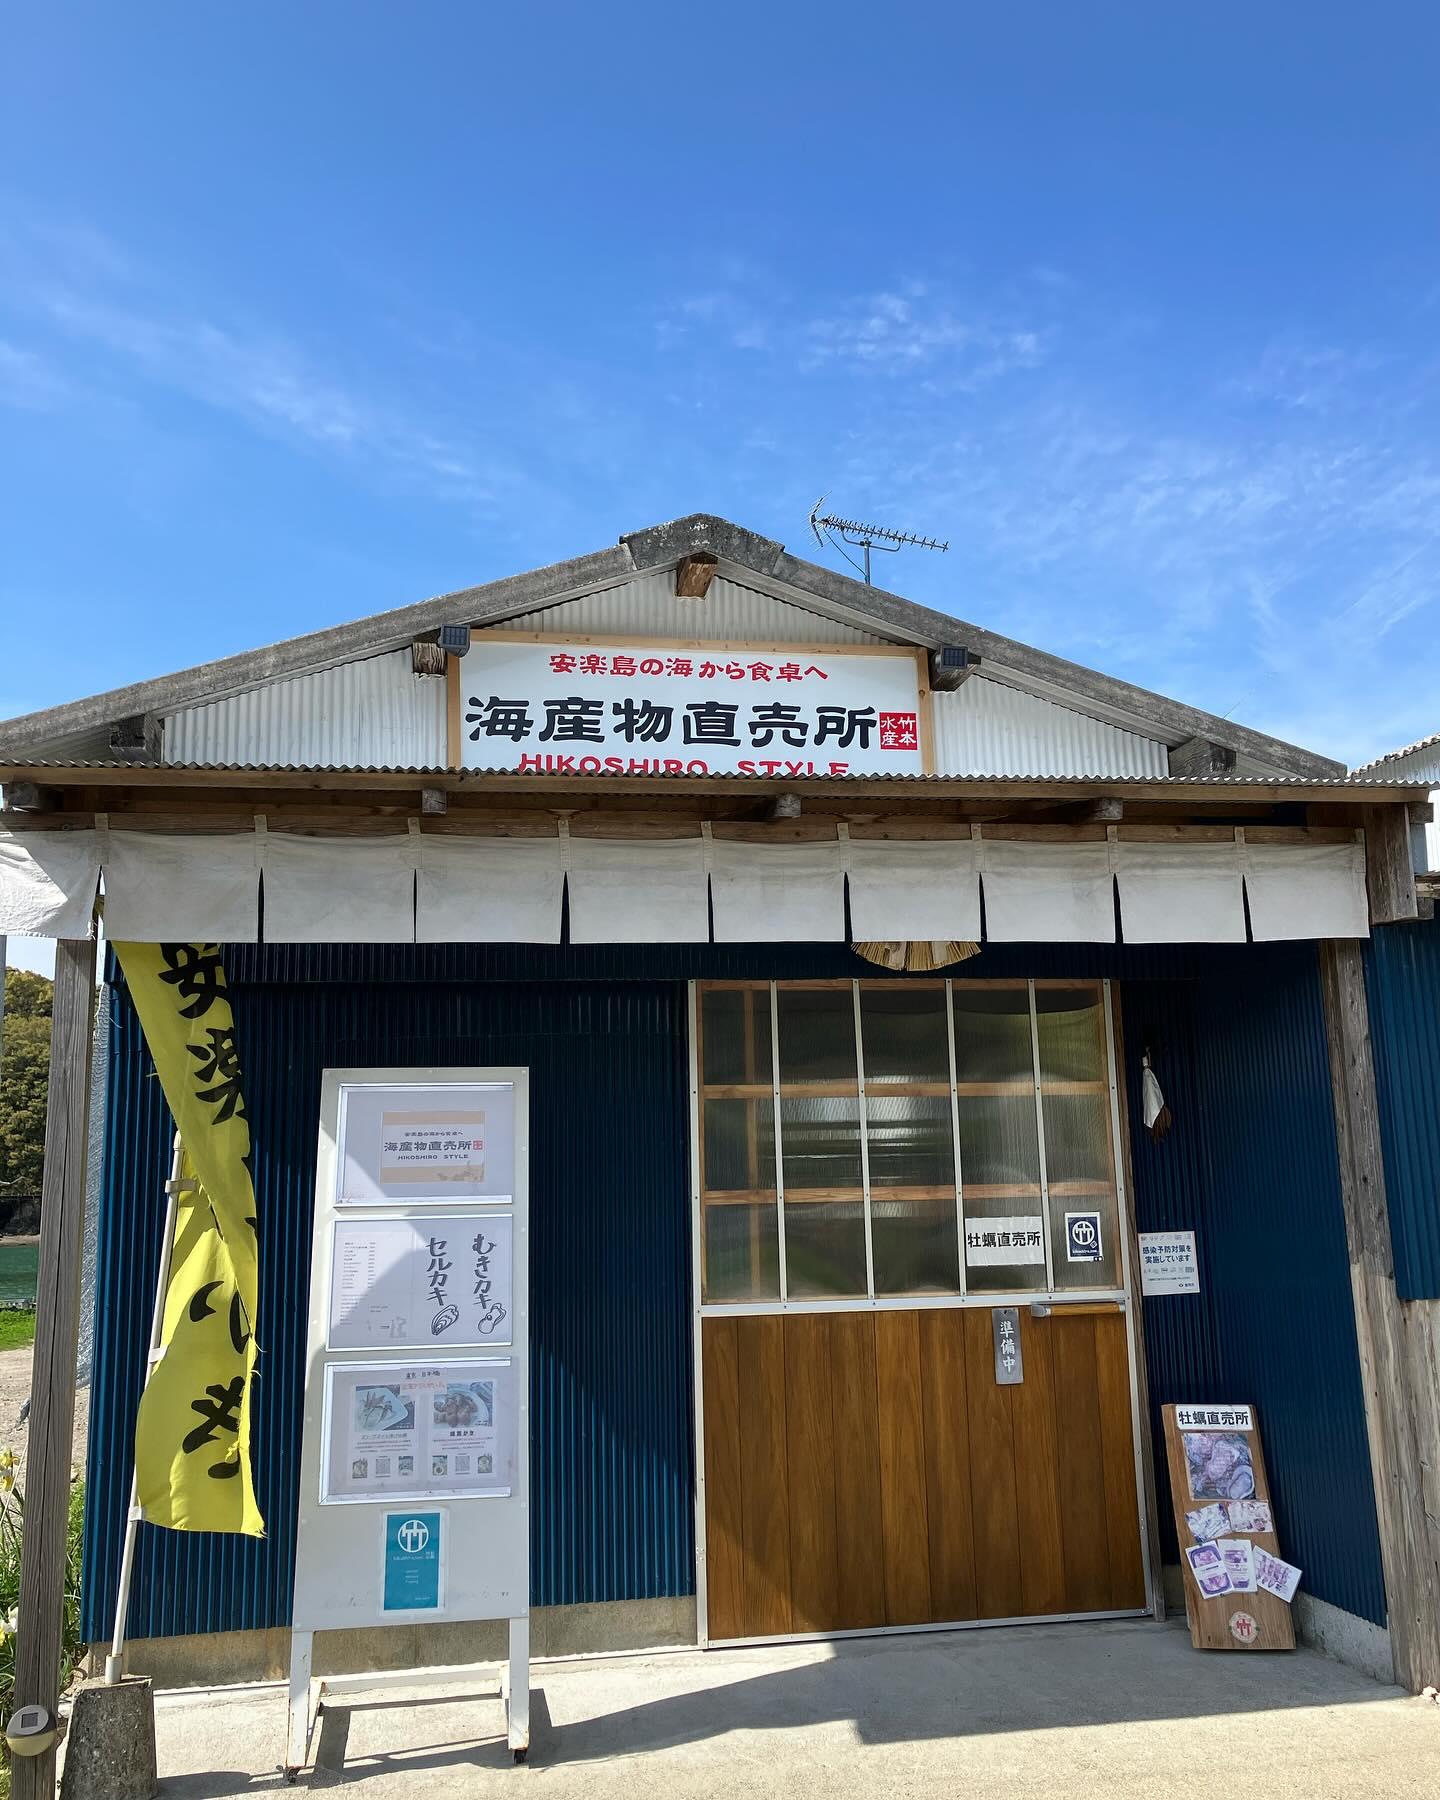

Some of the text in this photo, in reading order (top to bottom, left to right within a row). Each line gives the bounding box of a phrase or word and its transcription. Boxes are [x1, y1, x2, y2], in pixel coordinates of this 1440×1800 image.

[549, 652, 829, 683] 安楽島の海から食卓へ
[464, 696, 877, 750] 海産物直売所
[384, 1140, 471, 1152] 海産物直売所
[425, 1237, 453, 1306] セルカキ
[472, 1233, 497, 1310] むきカキ
[1000, 1320, 1017, 1373] 準備中
